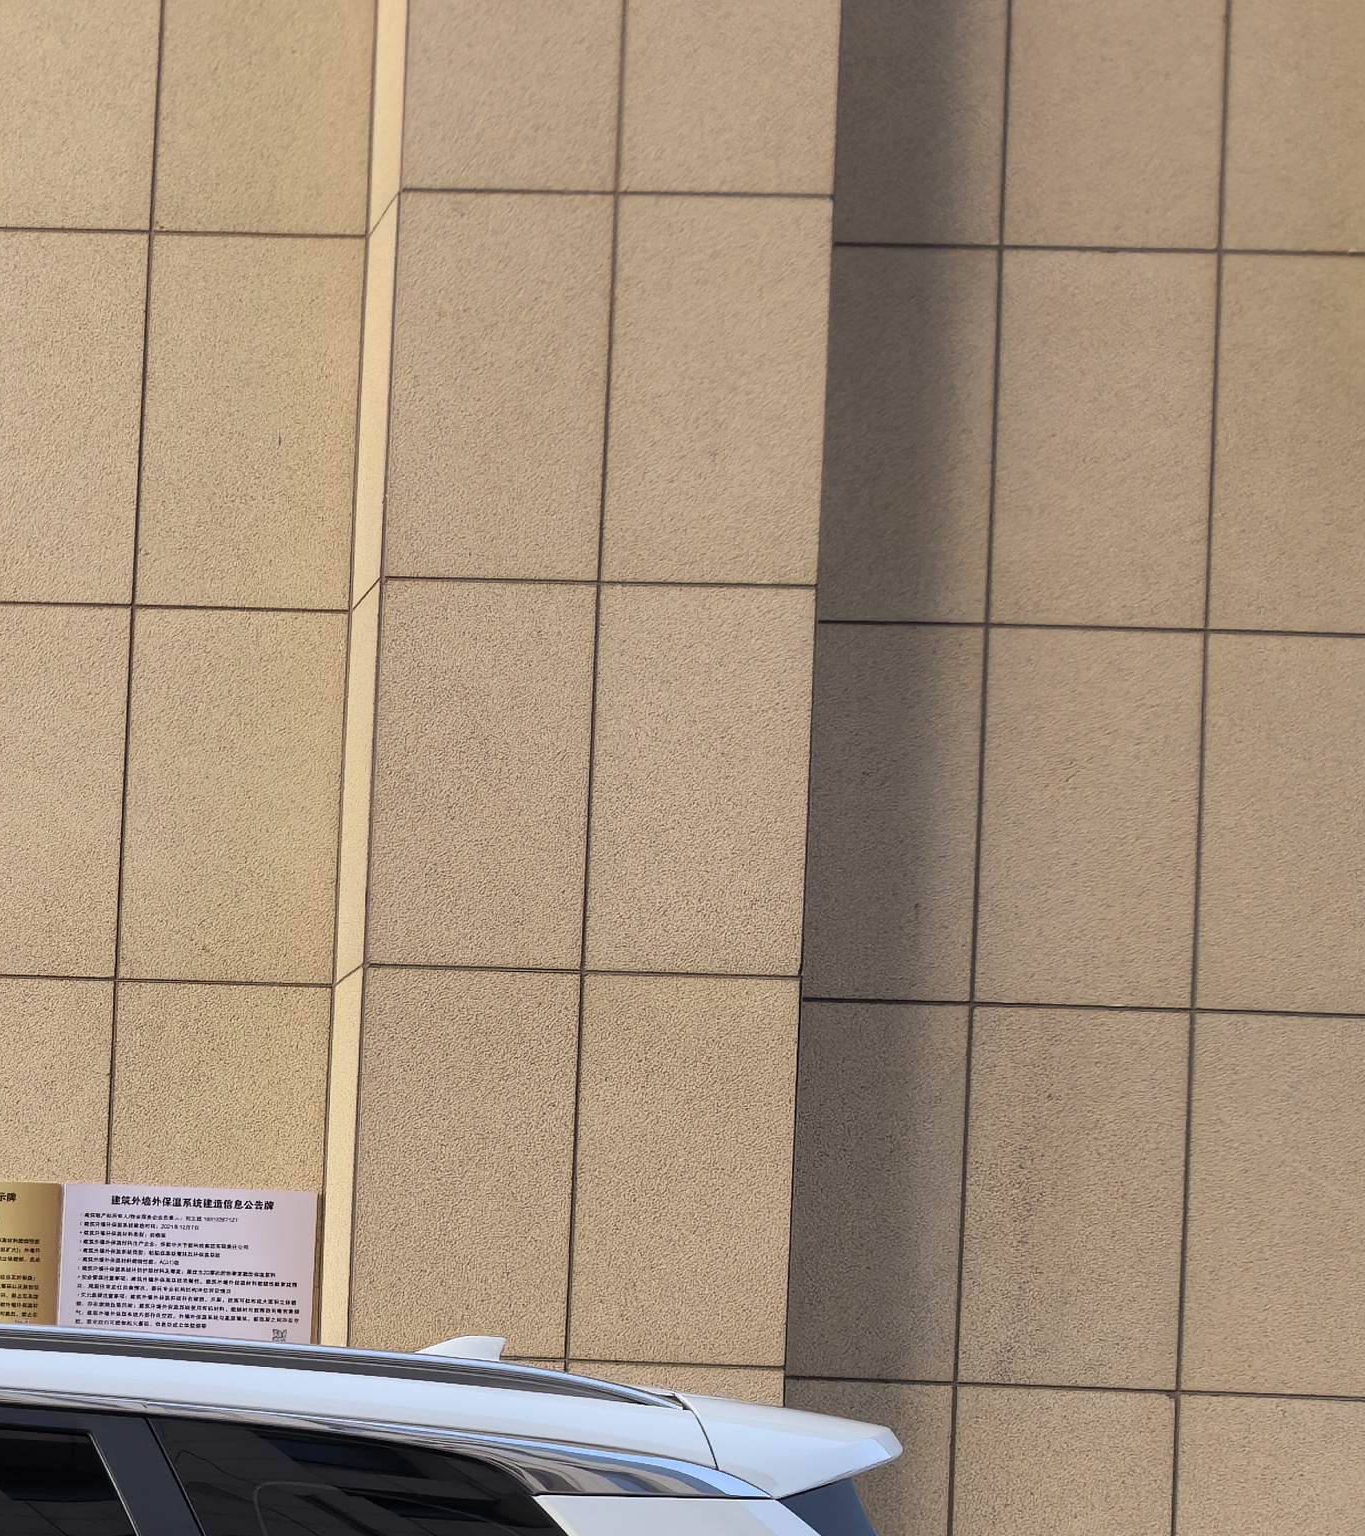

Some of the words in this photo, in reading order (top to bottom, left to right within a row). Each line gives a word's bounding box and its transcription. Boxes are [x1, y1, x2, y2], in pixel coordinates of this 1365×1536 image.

[111, 1195, 275, 1211] 建筑外墙外保温系统建造信息公告牌
